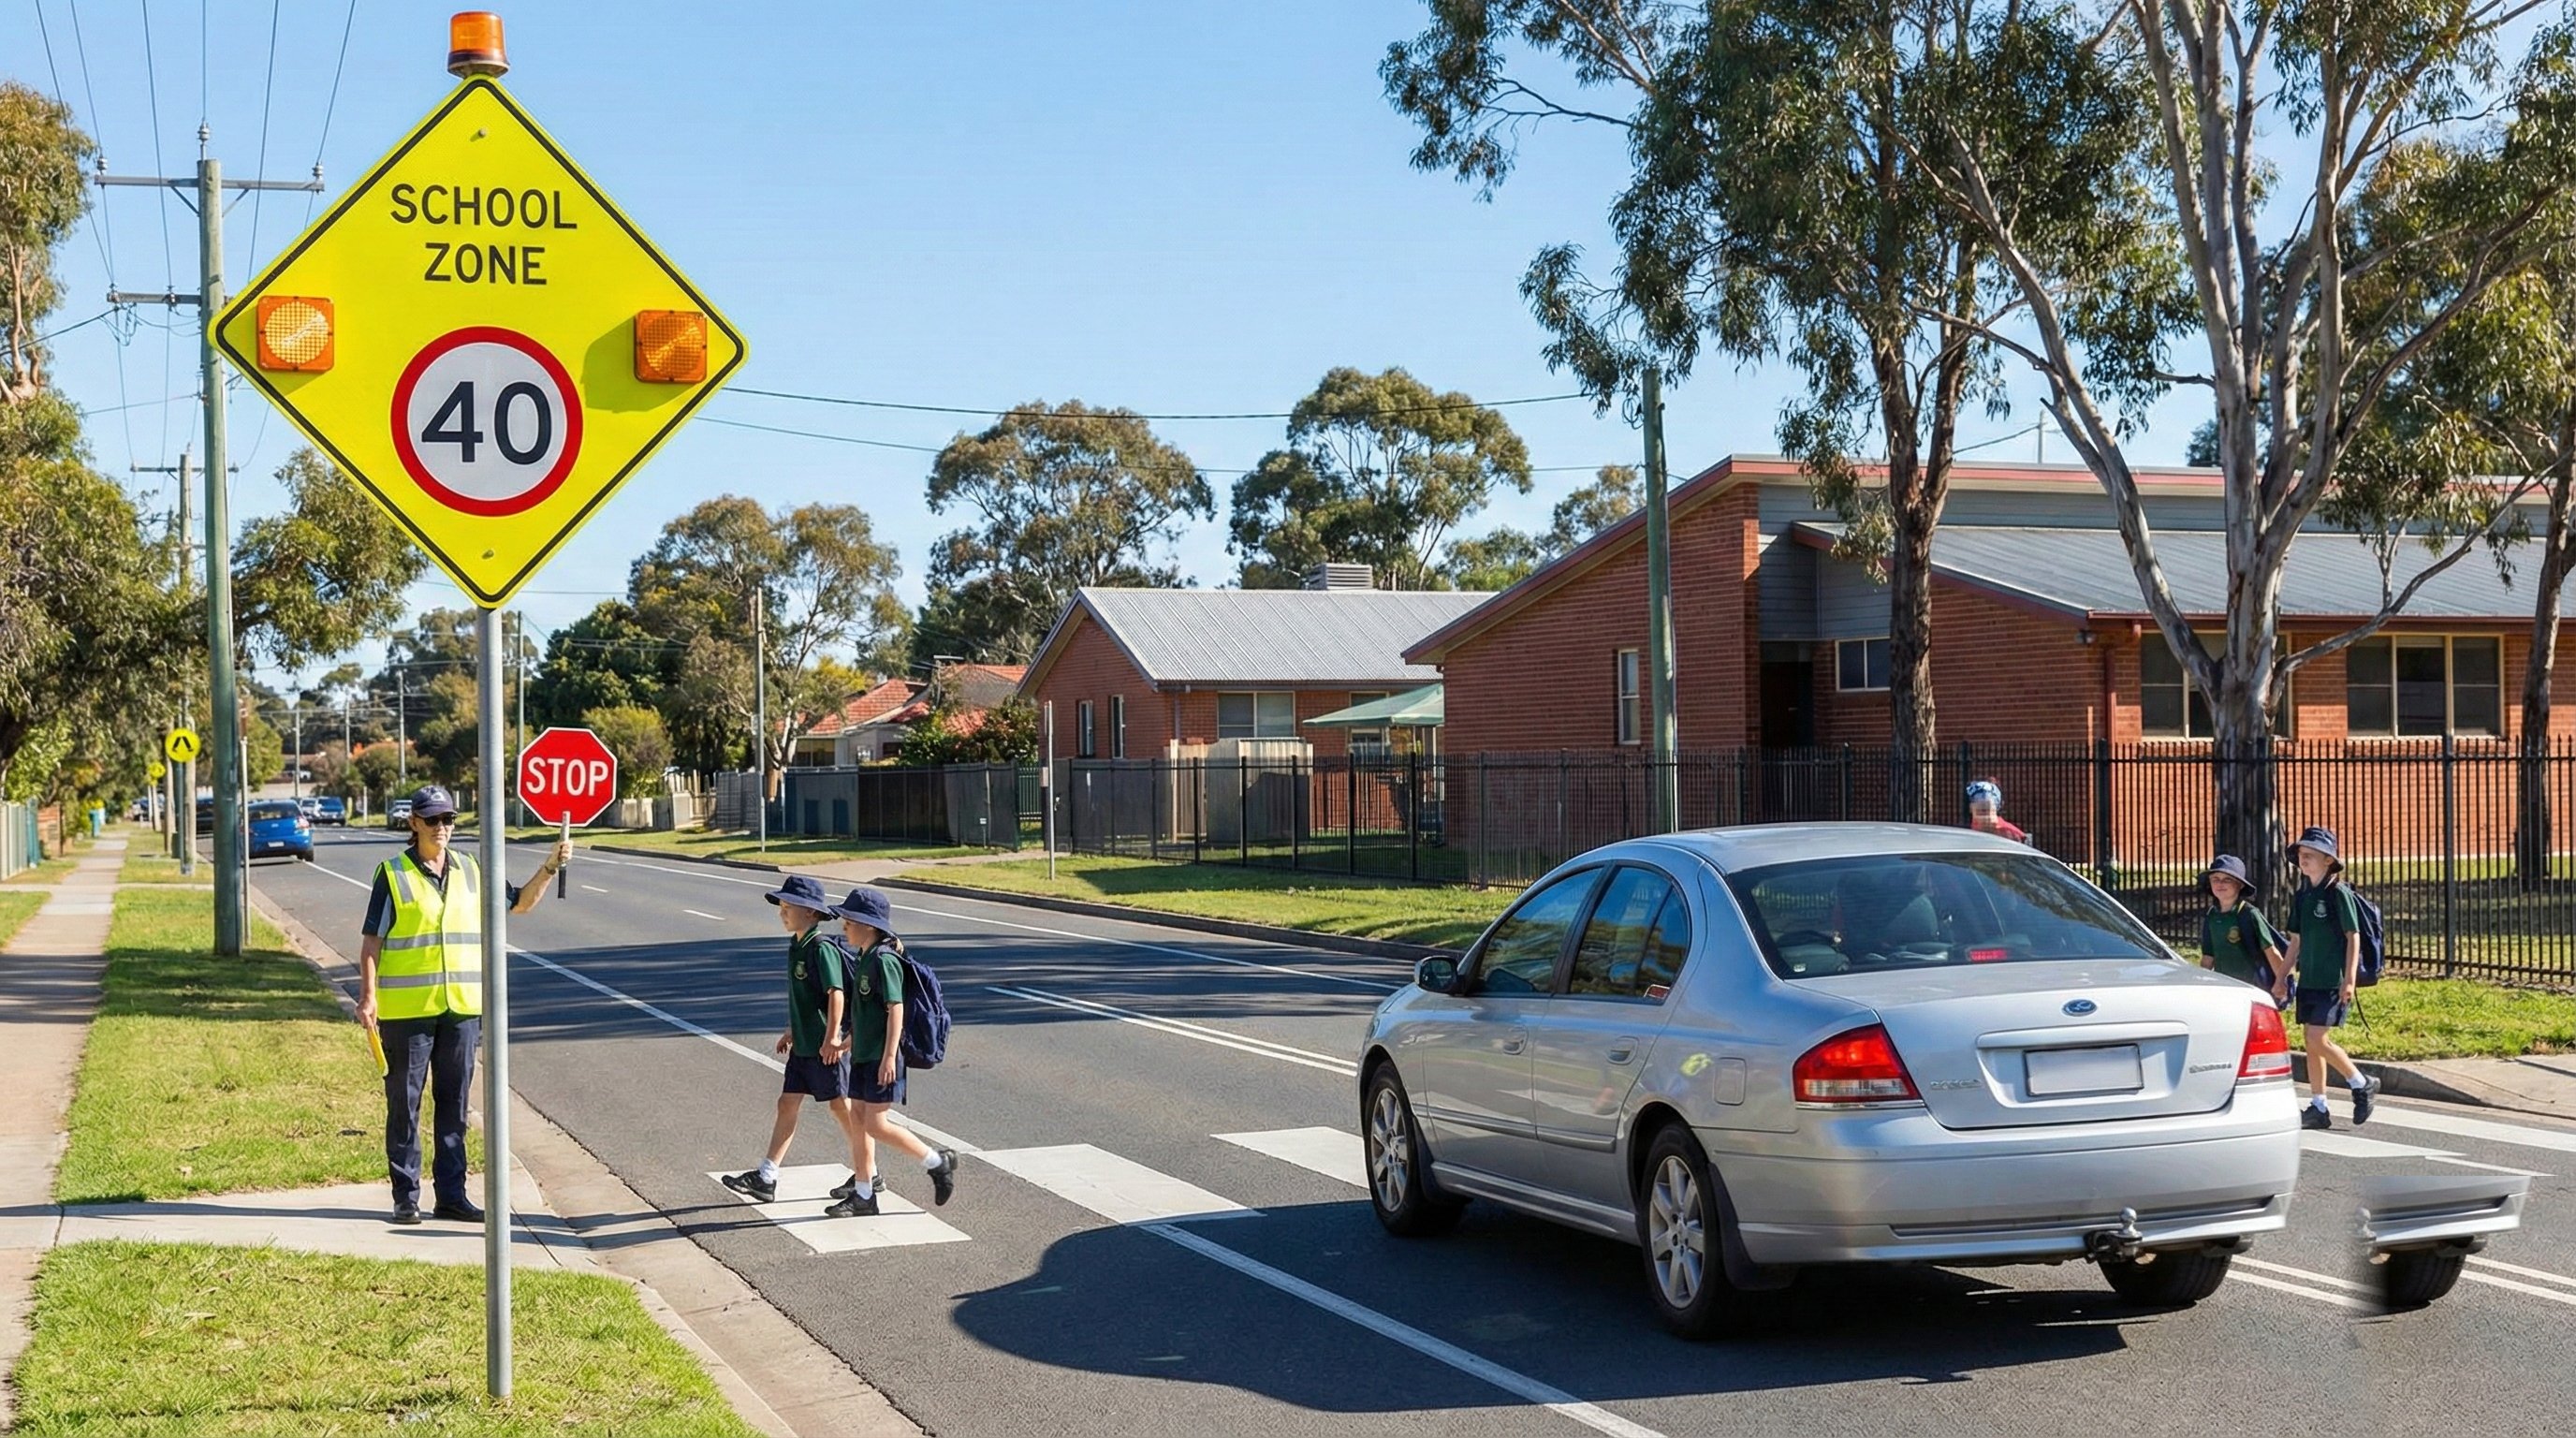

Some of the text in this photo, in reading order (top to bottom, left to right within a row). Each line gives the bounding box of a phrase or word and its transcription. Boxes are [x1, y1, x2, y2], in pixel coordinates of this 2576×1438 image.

[389, 183, 578, 229] SCHOOL
[424, 242, 548, 286] ZONE
[420, 380, 553, 465] 40
[526, 756, 608, 797] STOP
